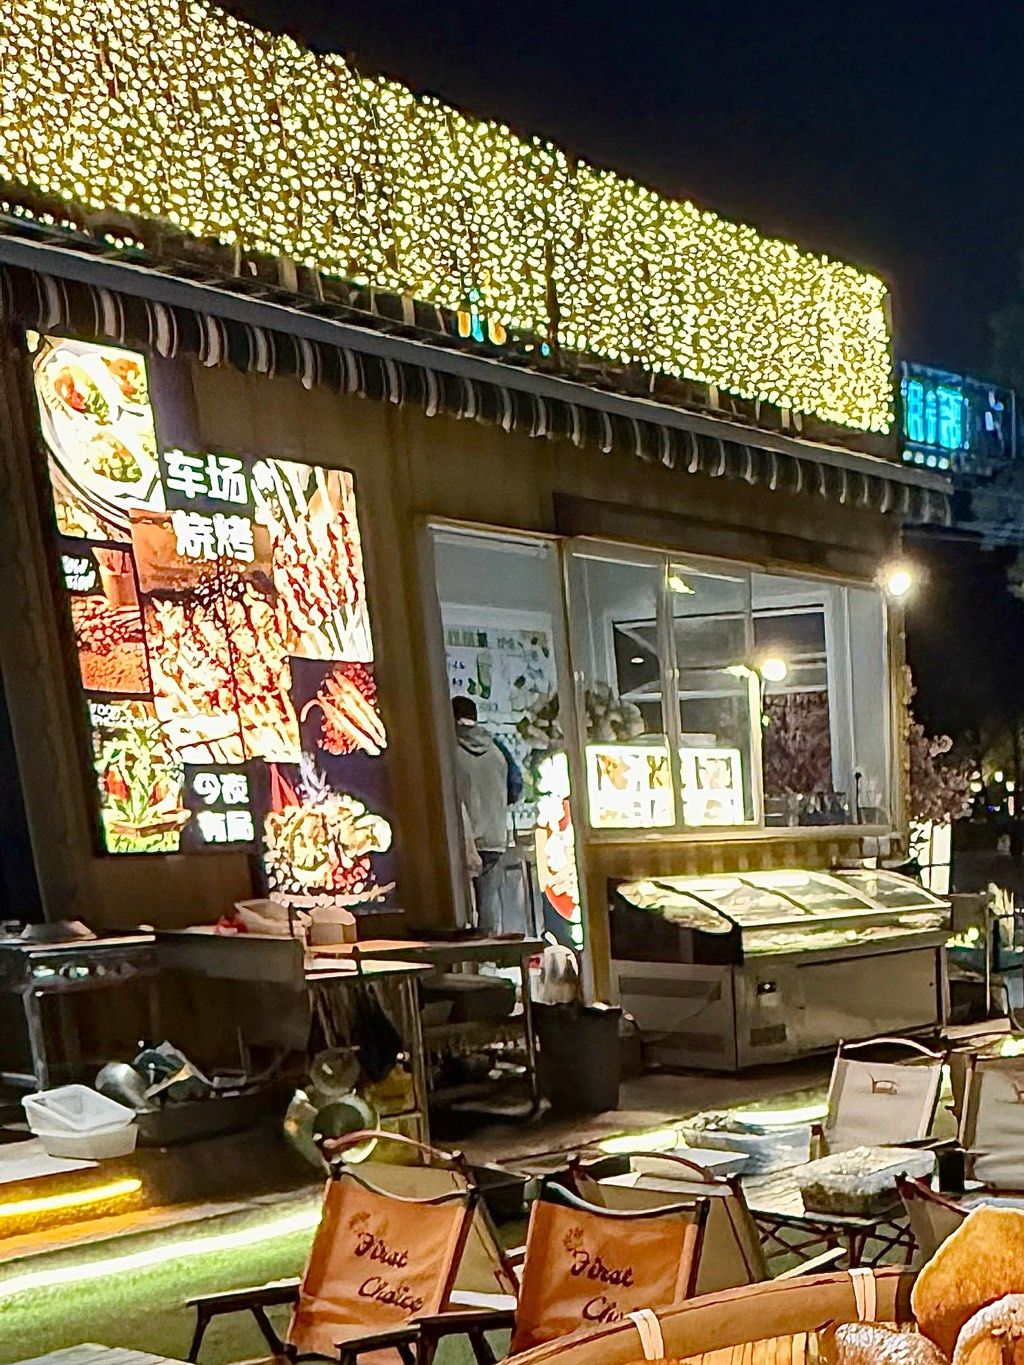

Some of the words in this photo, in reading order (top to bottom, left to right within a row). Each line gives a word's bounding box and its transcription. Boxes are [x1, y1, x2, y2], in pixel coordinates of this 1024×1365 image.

[163, 448, 248, 504] 车场
[171, 509, 255, 563] 烧烤
[354, 1231, 408, 1269] First
[570, 1249, 634, 1288] First
